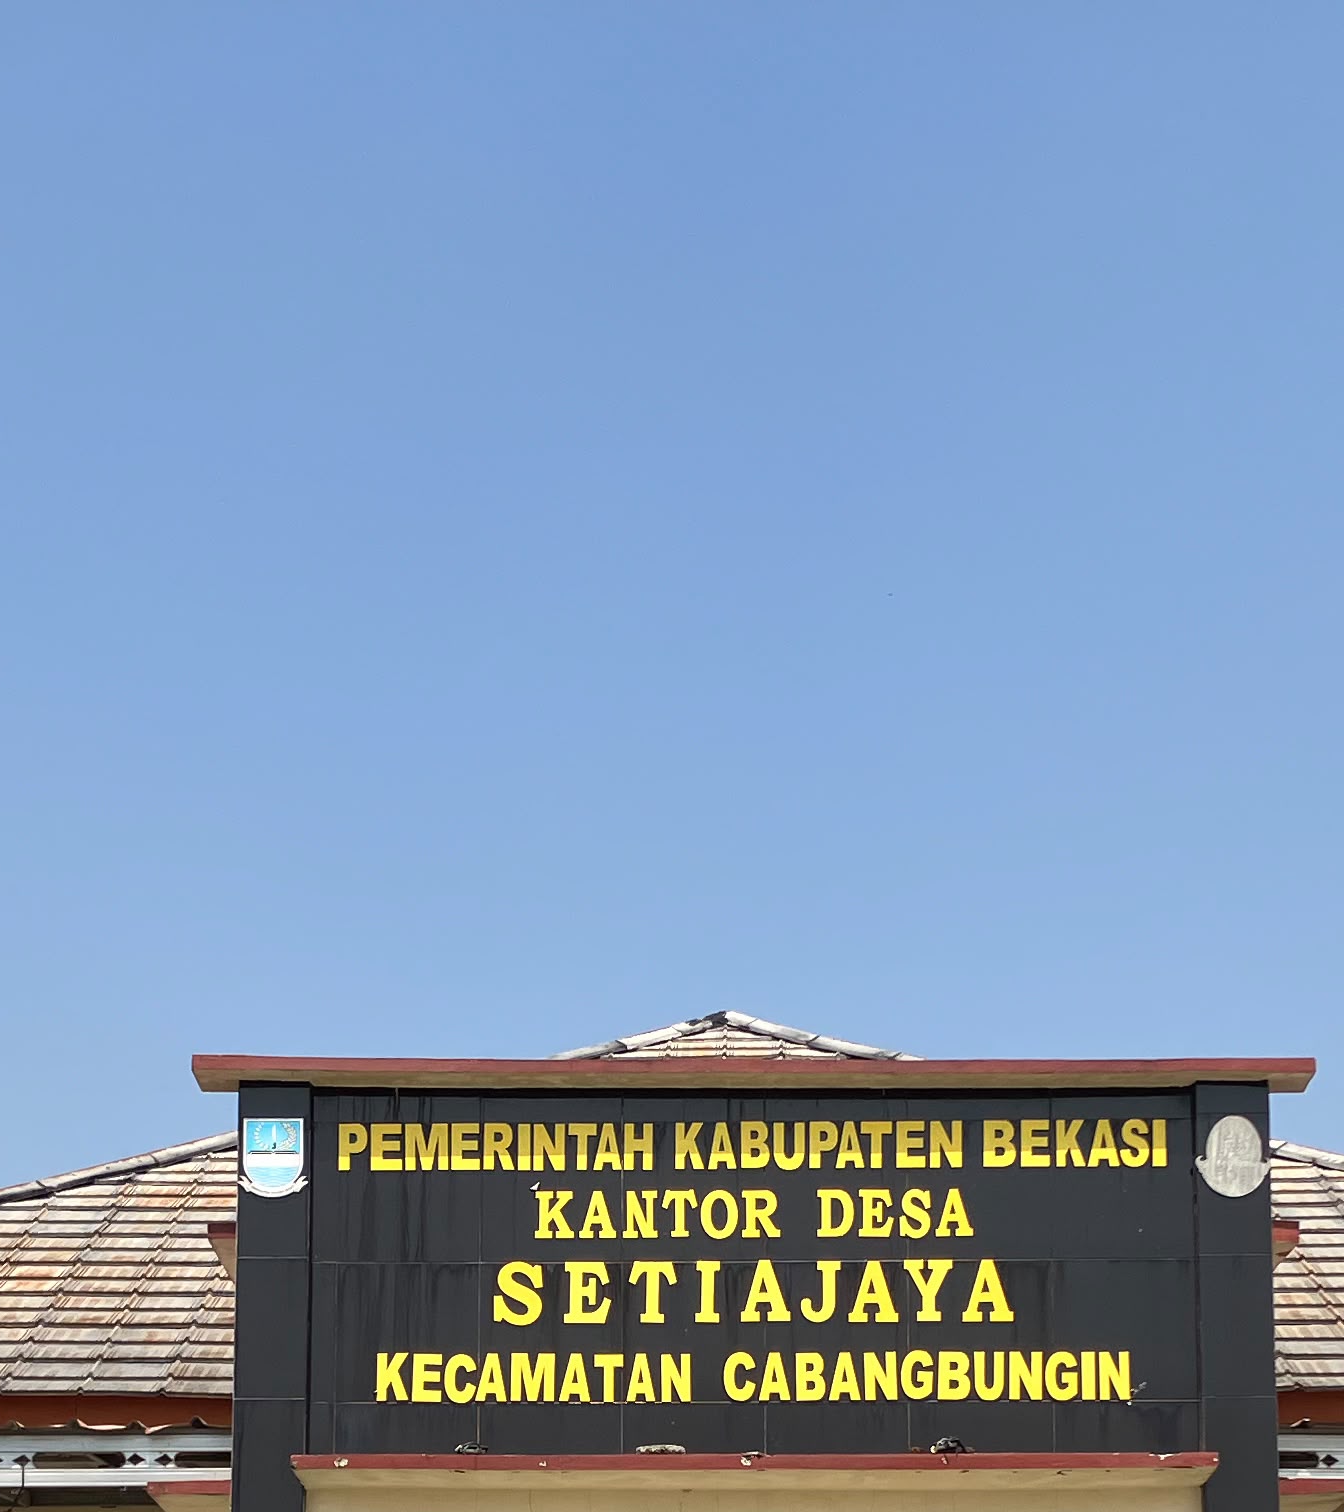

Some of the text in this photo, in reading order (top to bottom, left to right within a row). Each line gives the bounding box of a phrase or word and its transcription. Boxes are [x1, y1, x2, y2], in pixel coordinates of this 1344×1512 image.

[339, 1118, 1169, 1172] PEMERINTAH KABUPATEN BEKASI
[535, 1188, 975, 1240] KANTOR DESA
[493, 1258, 1015, 1327] SETIAJAYA
[376, 1349, 1132, 1404] KECAMATAN CABANGBUNGIN
